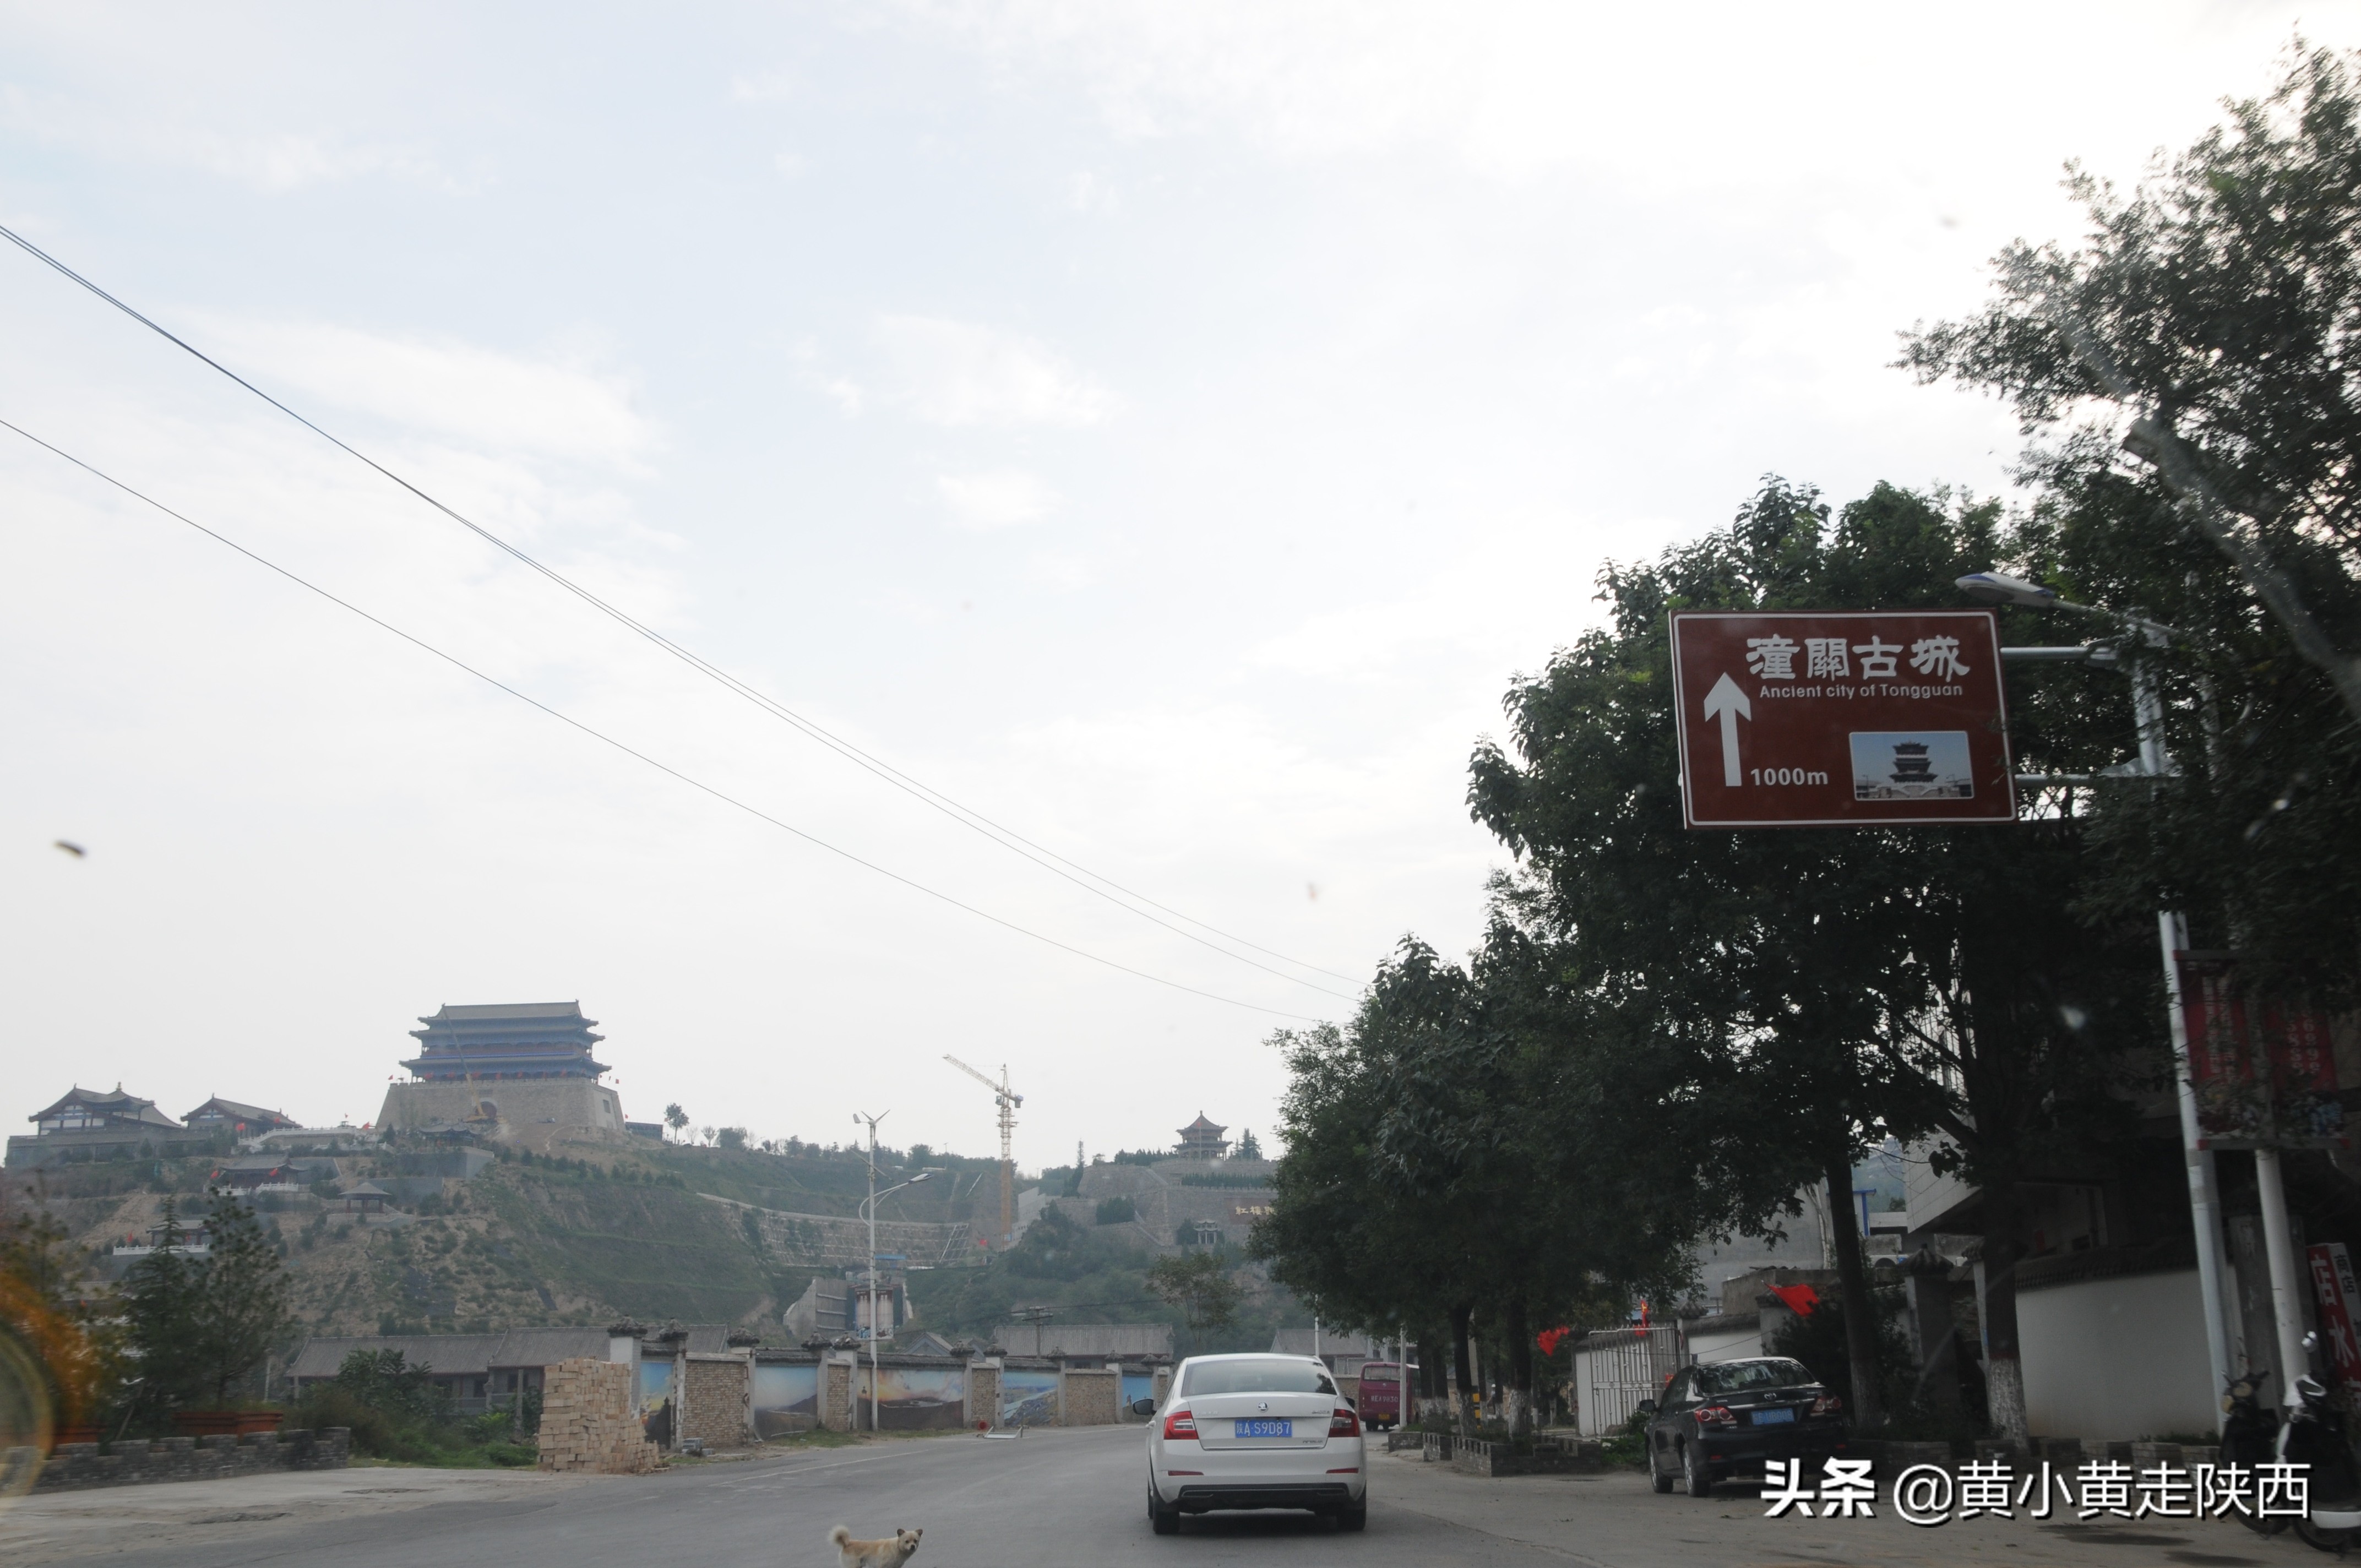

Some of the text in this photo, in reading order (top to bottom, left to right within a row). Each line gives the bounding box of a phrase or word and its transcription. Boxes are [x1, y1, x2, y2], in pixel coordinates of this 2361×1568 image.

[1746, 634, 1970, 682] 潼關古城
[1760, 683, 1962, 700] Ancient city of Tongguan
[1750, 768, 1829, 787] 1000m
